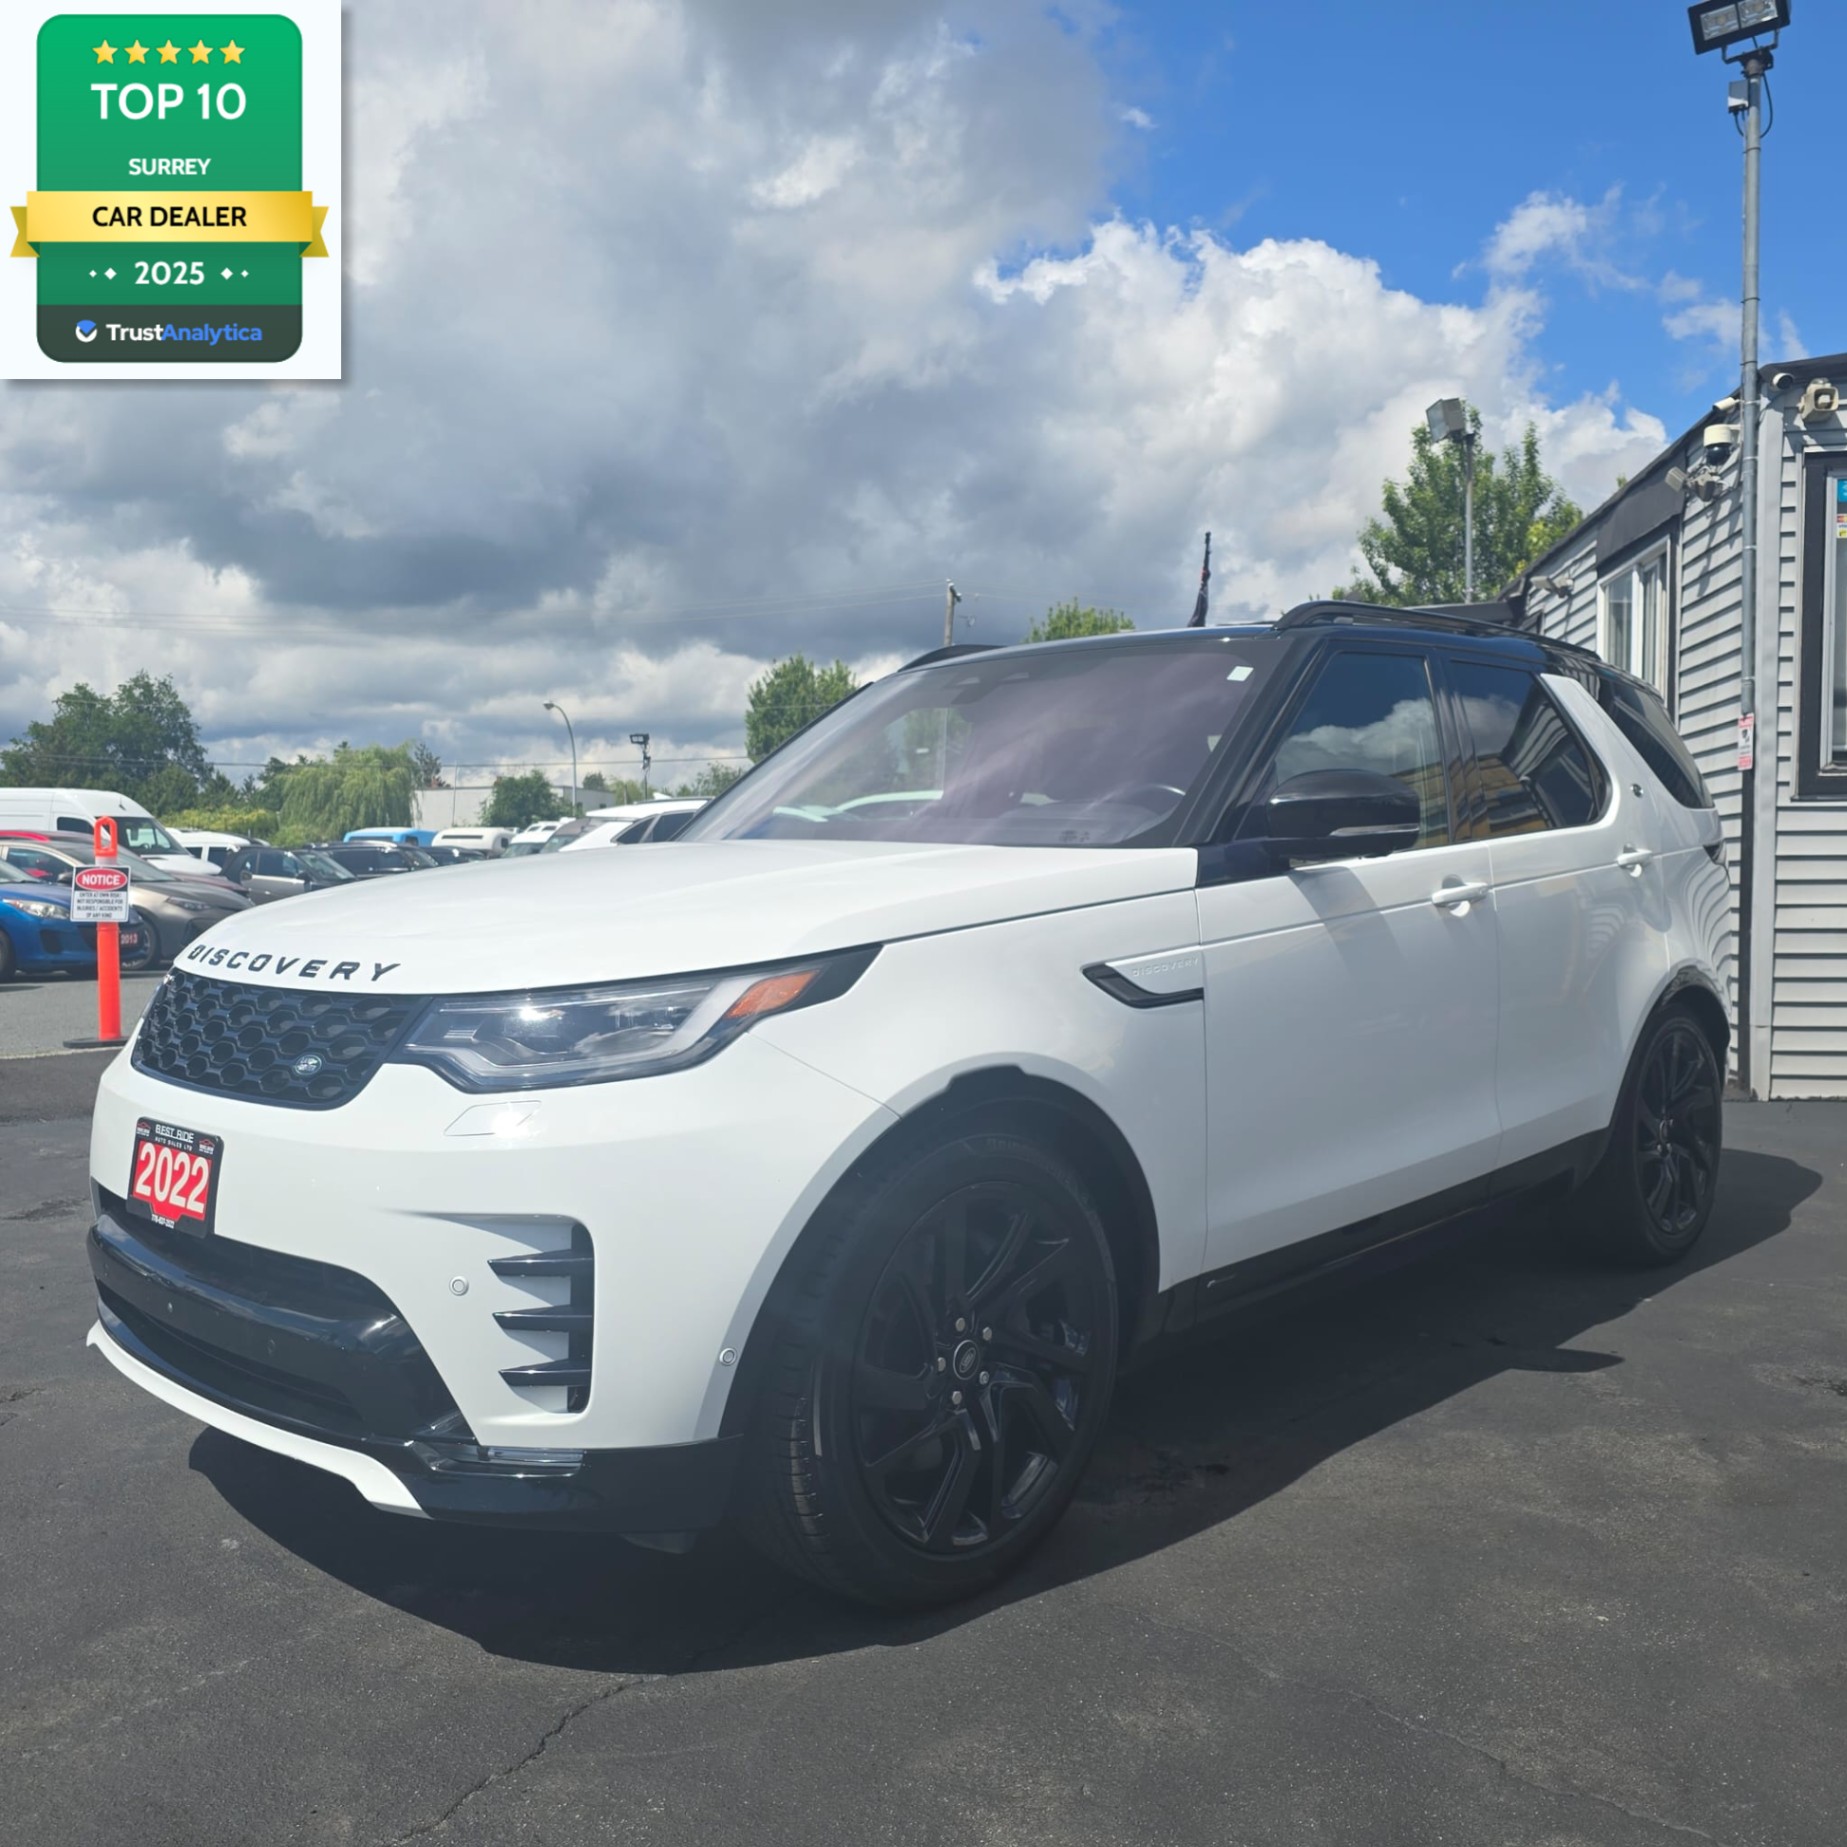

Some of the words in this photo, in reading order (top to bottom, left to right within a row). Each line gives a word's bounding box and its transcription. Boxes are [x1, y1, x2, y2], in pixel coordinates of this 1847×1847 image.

[82, 874, 121, 885] NOTICE
[187, 944, 401, 982] DISCOVERY
[1132, 958, 1198, 976] DISCOVERY
[155, 1124, 174, 1138] BEST
[176, 1130, 195, 1142] RIDE
[135, 1142, 210, 1214] 2022
